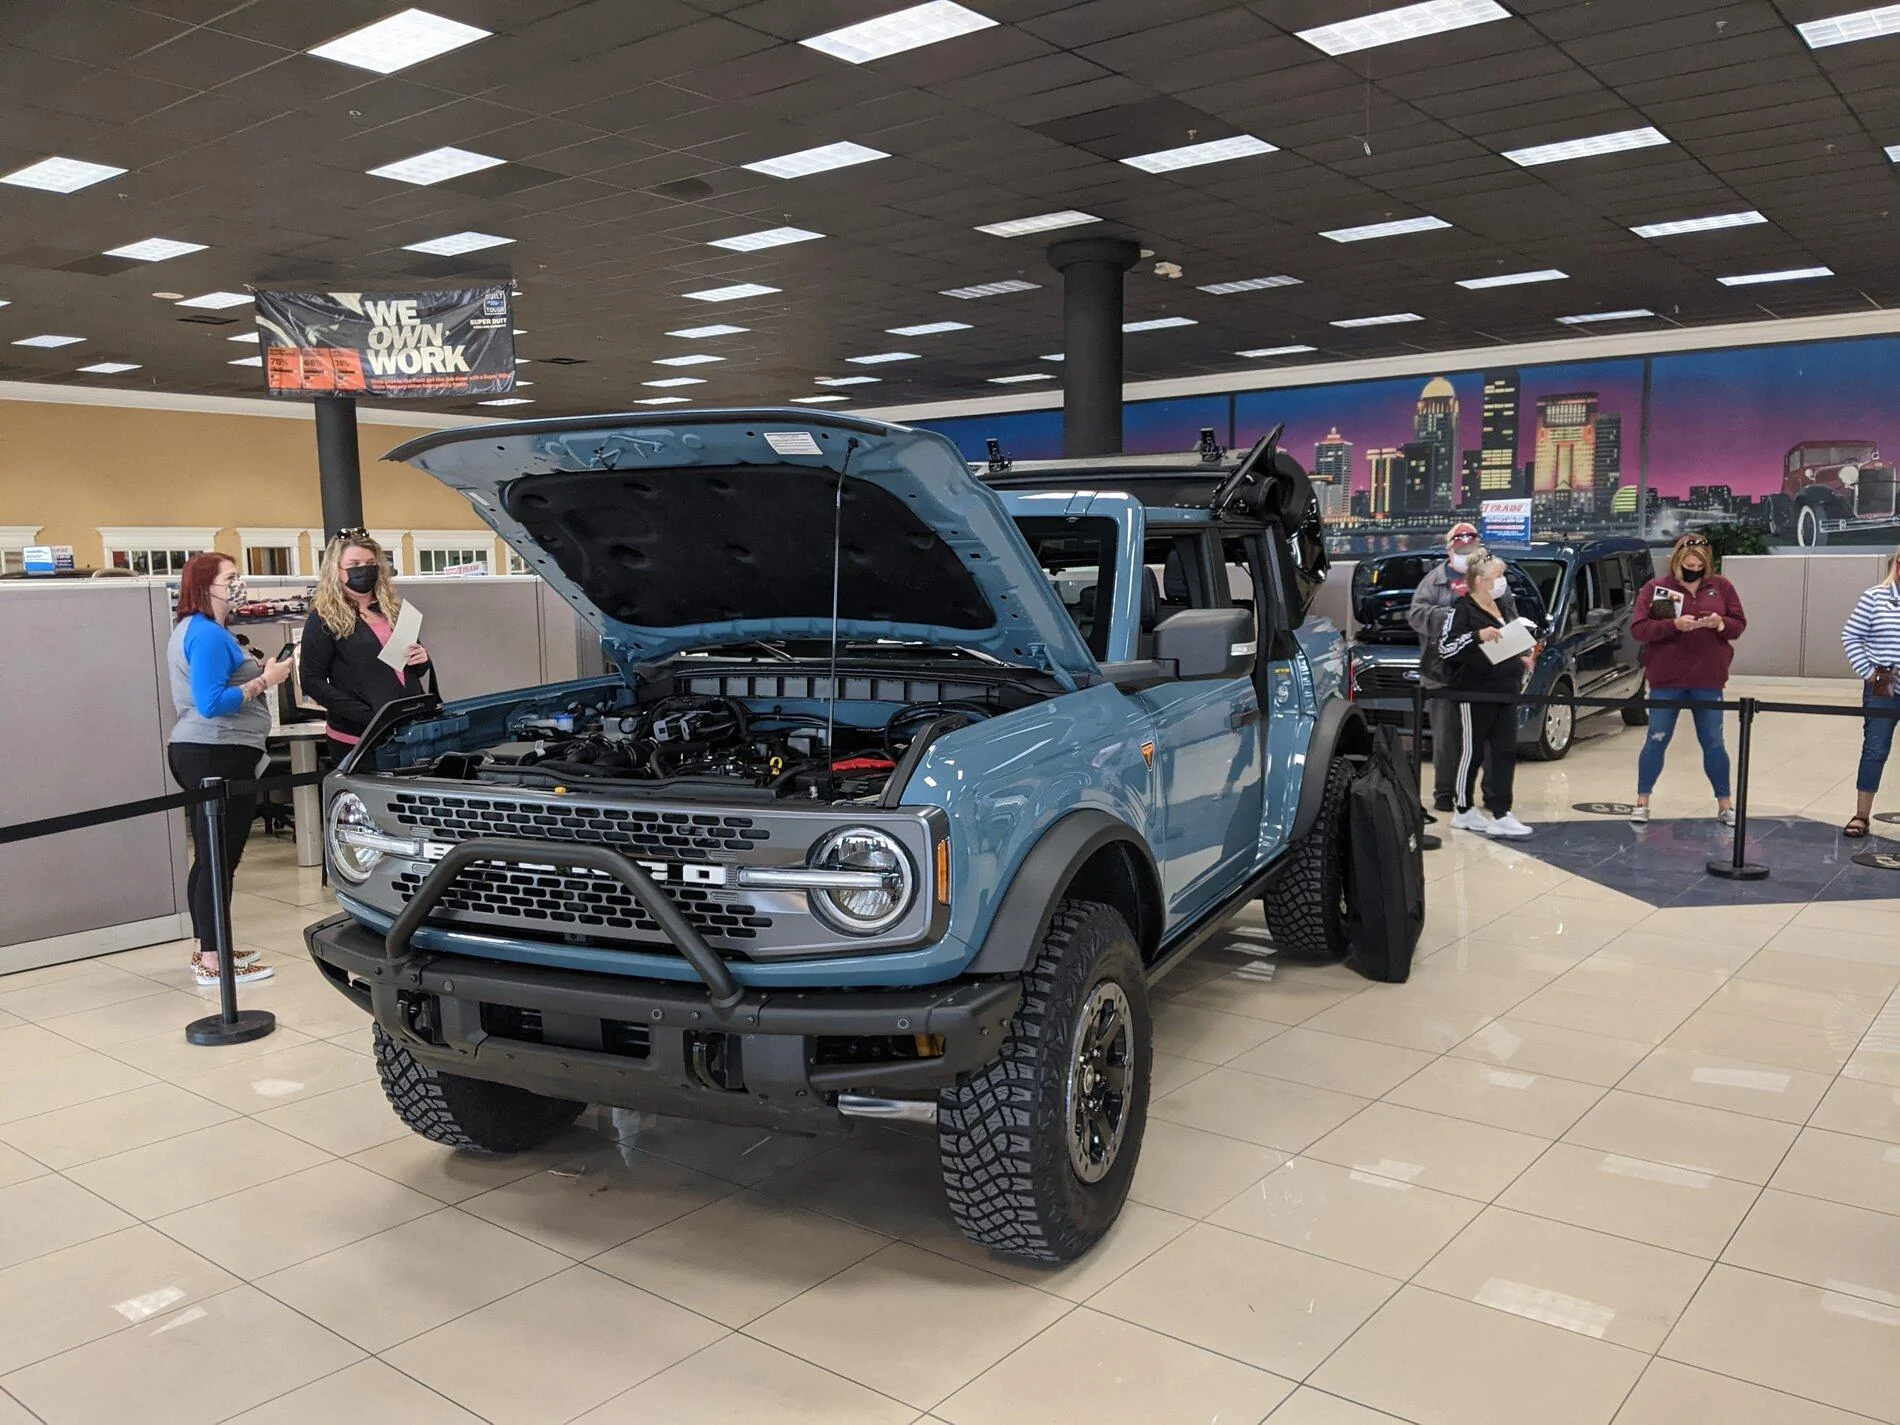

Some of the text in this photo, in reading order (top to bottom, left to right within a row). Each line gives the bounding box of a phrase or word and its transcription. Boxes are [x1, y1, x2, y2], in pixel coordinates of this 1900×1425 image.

[365, 300, 421, 326] WE
[469, 317, 508, 326] SUPER DUTY
[368, 323, 443, 350] OWN
[367, 345, 471, 375] WORK
